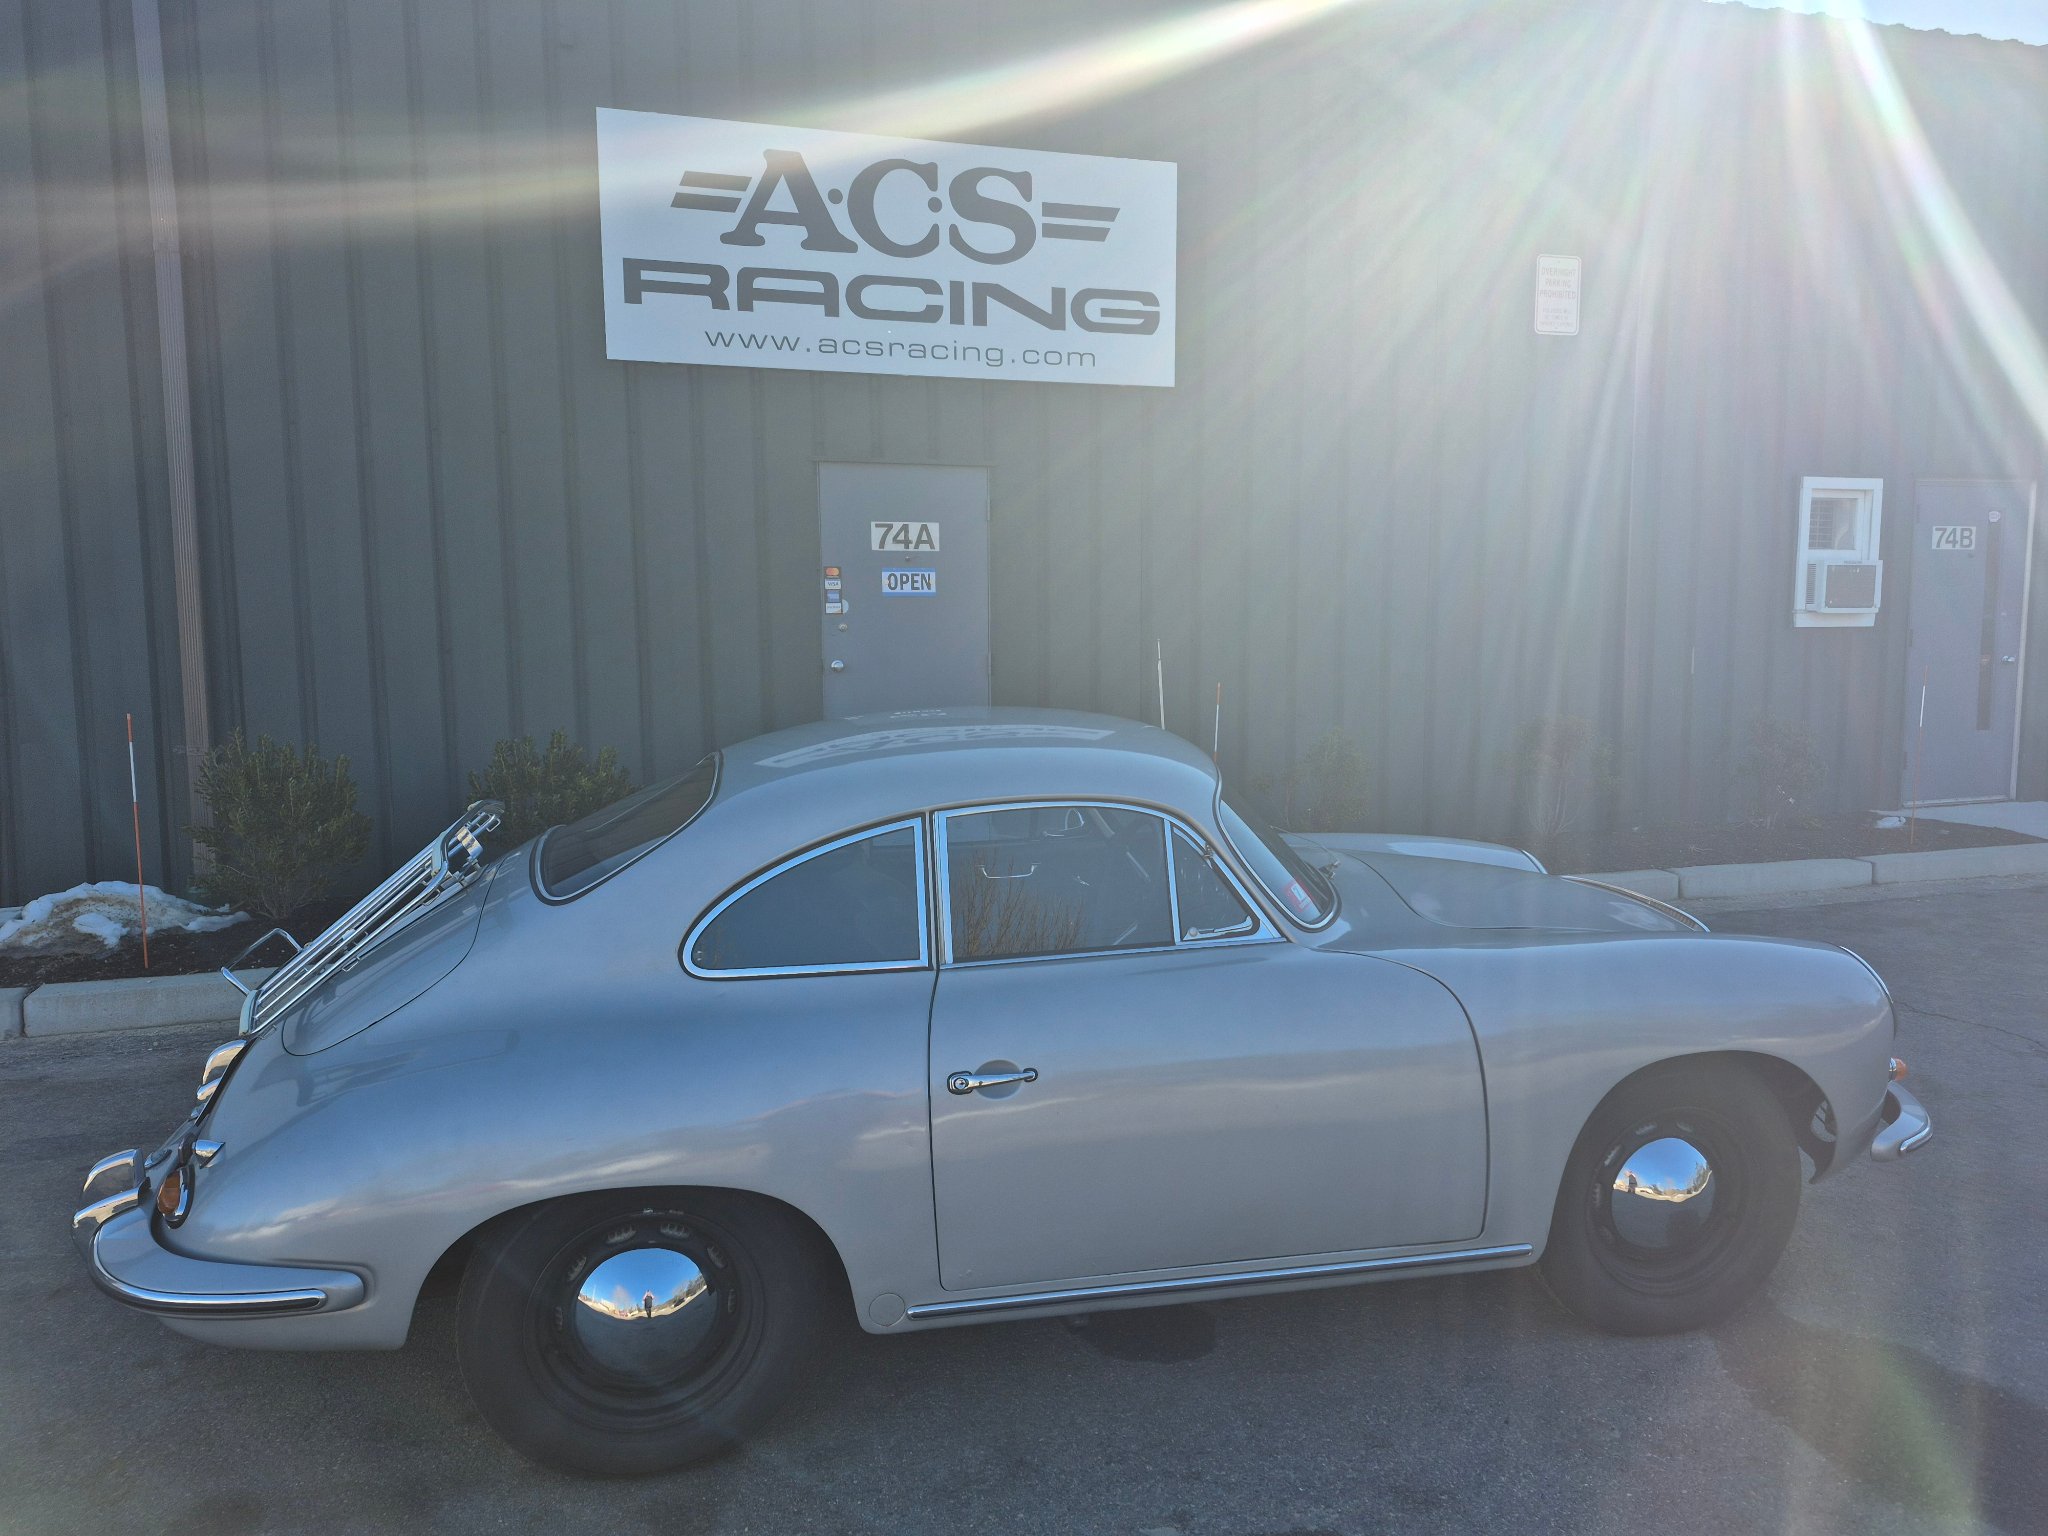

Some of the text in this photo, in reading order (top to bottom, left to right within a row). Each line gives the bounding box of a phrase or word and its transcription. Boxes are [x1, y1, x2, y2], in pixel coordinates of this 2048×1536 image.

[1539, 289, 1577, 300] PROHIBITED
[1545, 279, 1572, 289] PARKING
[622, 257, 1160, 336] RACING
[704, 331, 1096, 368] www.acsracing.com
[874, 523, 936, 550] 74A
[1934, 527, 1973, 549] 74B
[887, 573, 932, 591] OPEN
